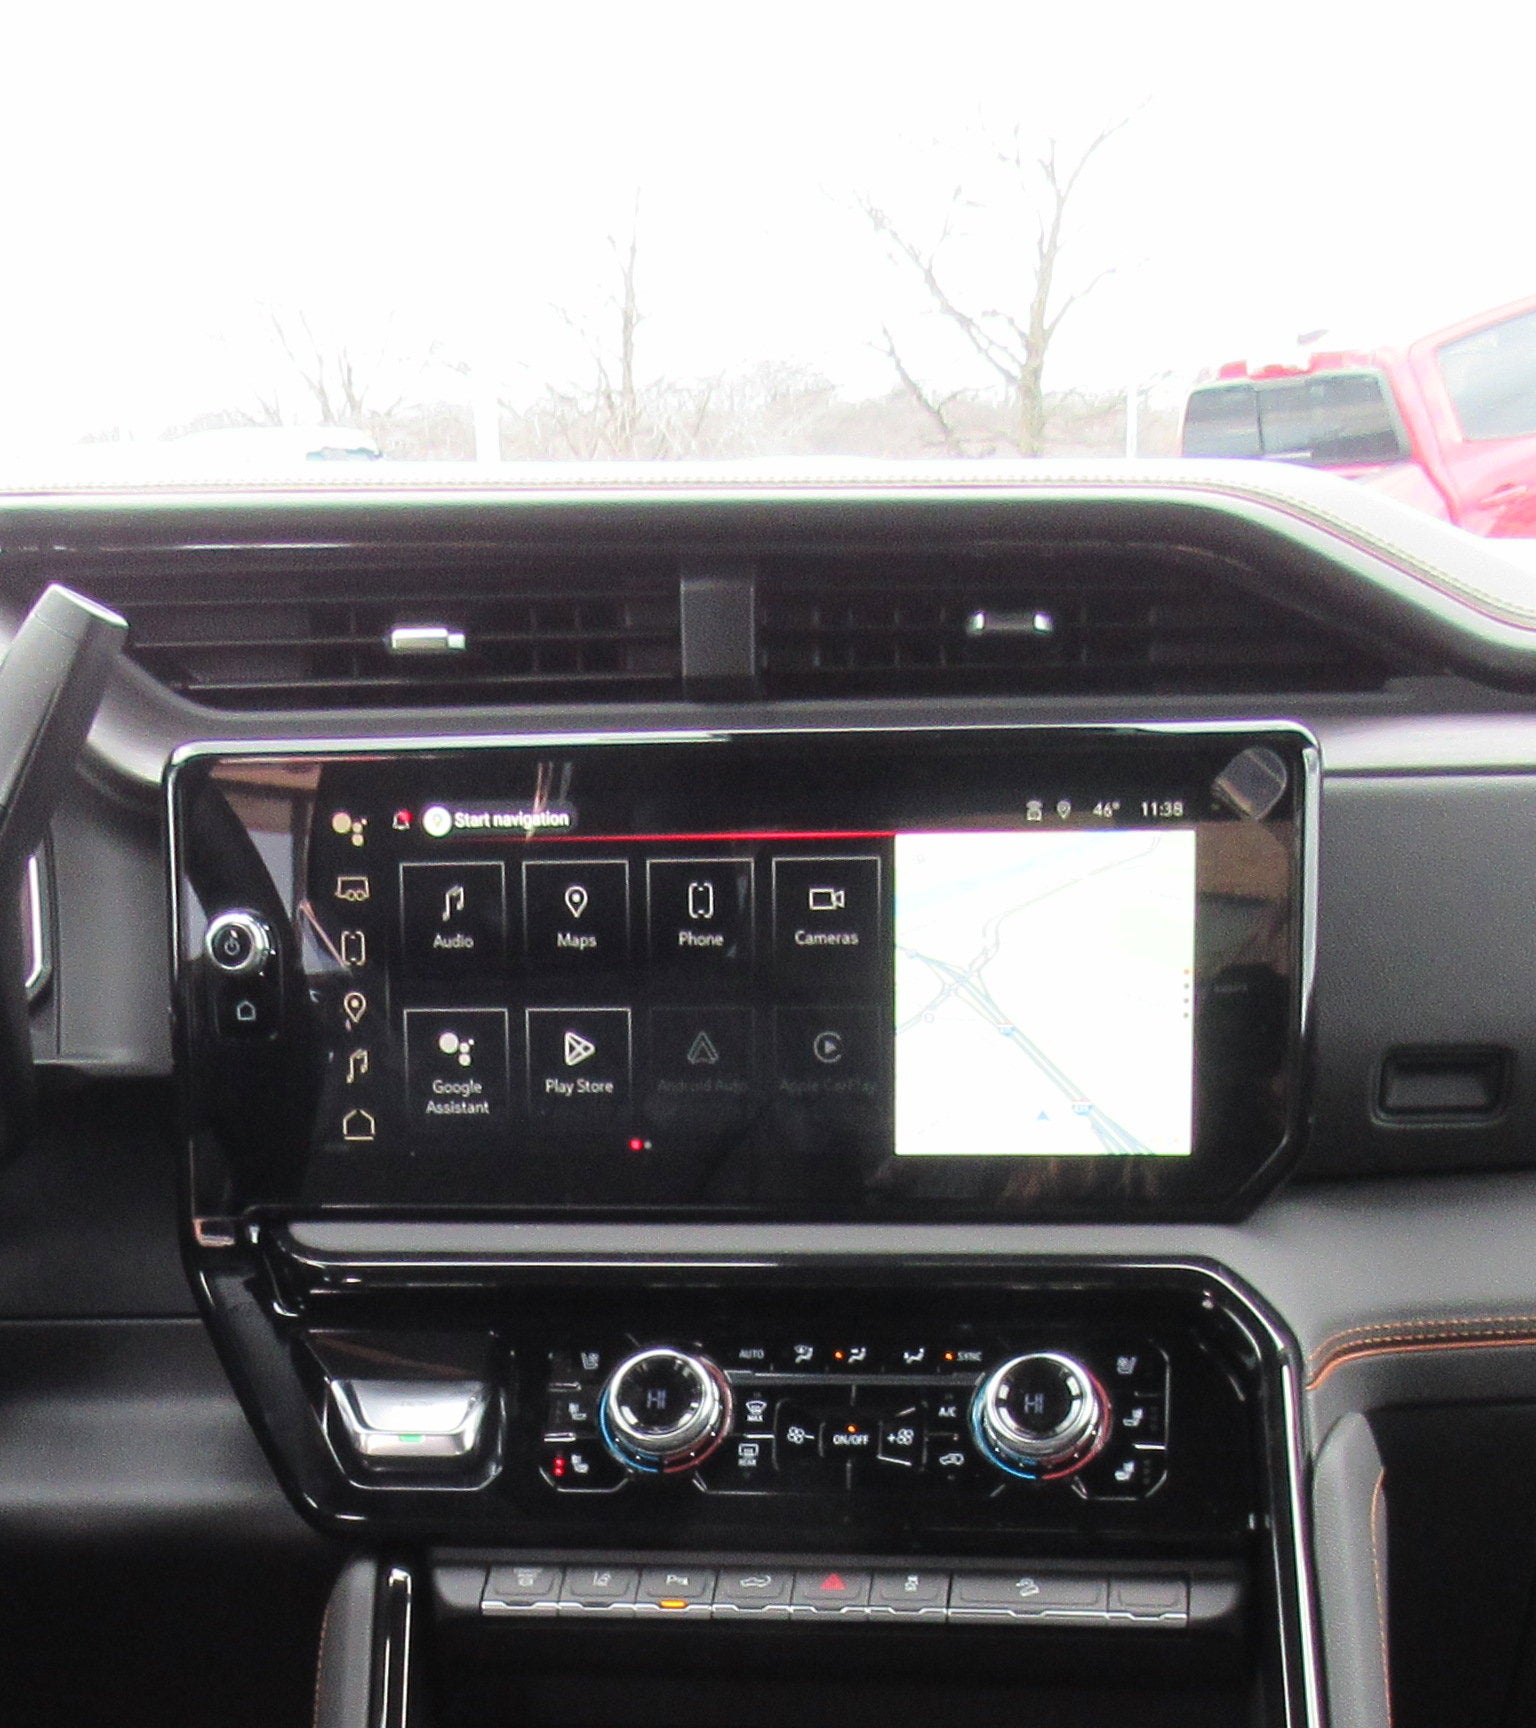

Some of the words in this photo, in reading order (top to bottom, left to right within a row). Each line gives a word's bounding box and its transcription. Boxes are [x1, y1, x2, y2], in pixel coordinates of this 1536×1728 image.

[1140, 801, 1184, 817] 11:38
[454, 811, 491, 829] Start
[492, 810, 570, 830] navigation
[432, 933, 474, 949] Audio
[557, 933, 597, 951] Maps
[678, 931, 724, 947] Phone
[794, 930, 859, 946] Cameras
[431, 1079, 483, 1096] Google
[545, 1080, 574, 1095] Play
[576, 1079, 614, 1095] Store
[426, 1099, 490, 1115] Assistant
[739, 1349, 764, 1359] AUTO
[938, 1406, 957, 1418] A/C
[833, 1434, 869, 1445] ON/OFF
